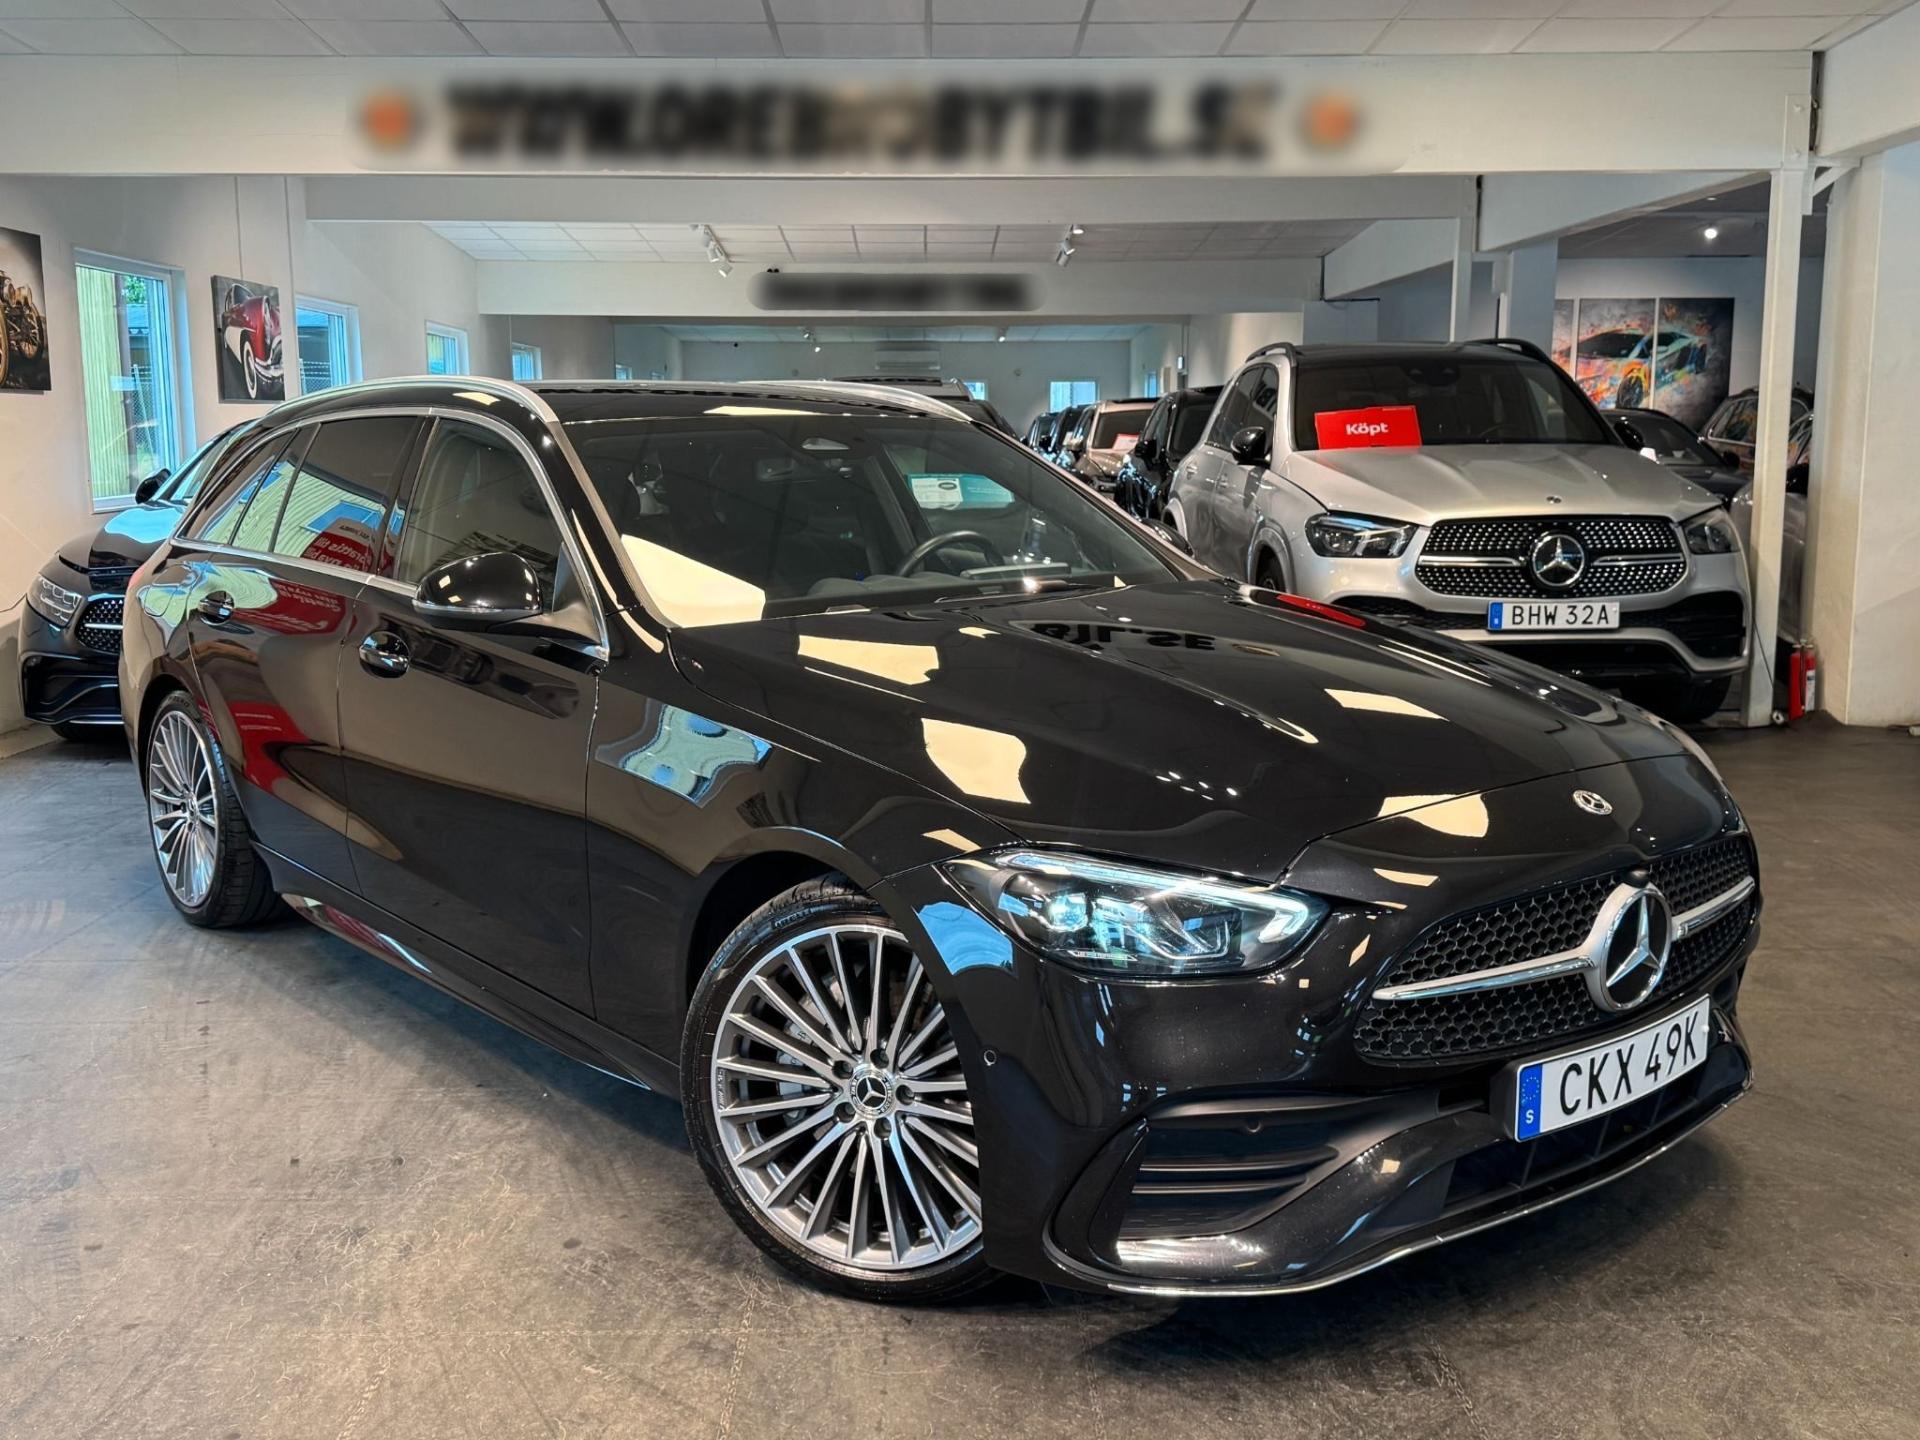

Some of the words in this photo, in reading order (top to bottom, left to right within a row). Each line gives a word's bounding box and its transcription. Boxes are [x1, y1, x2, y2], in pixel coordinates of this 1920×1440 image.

[1346, 422, 1388, 437] Köpt
[1511, 604, 1558, 626] BHW
[1565, 604, 1609, 625] 32A
[1559, 1043, 1635, 1116] CKX
[1644, 1010, 1699, 1083] 49K
[1525, 1109, 1535, 1125] S
